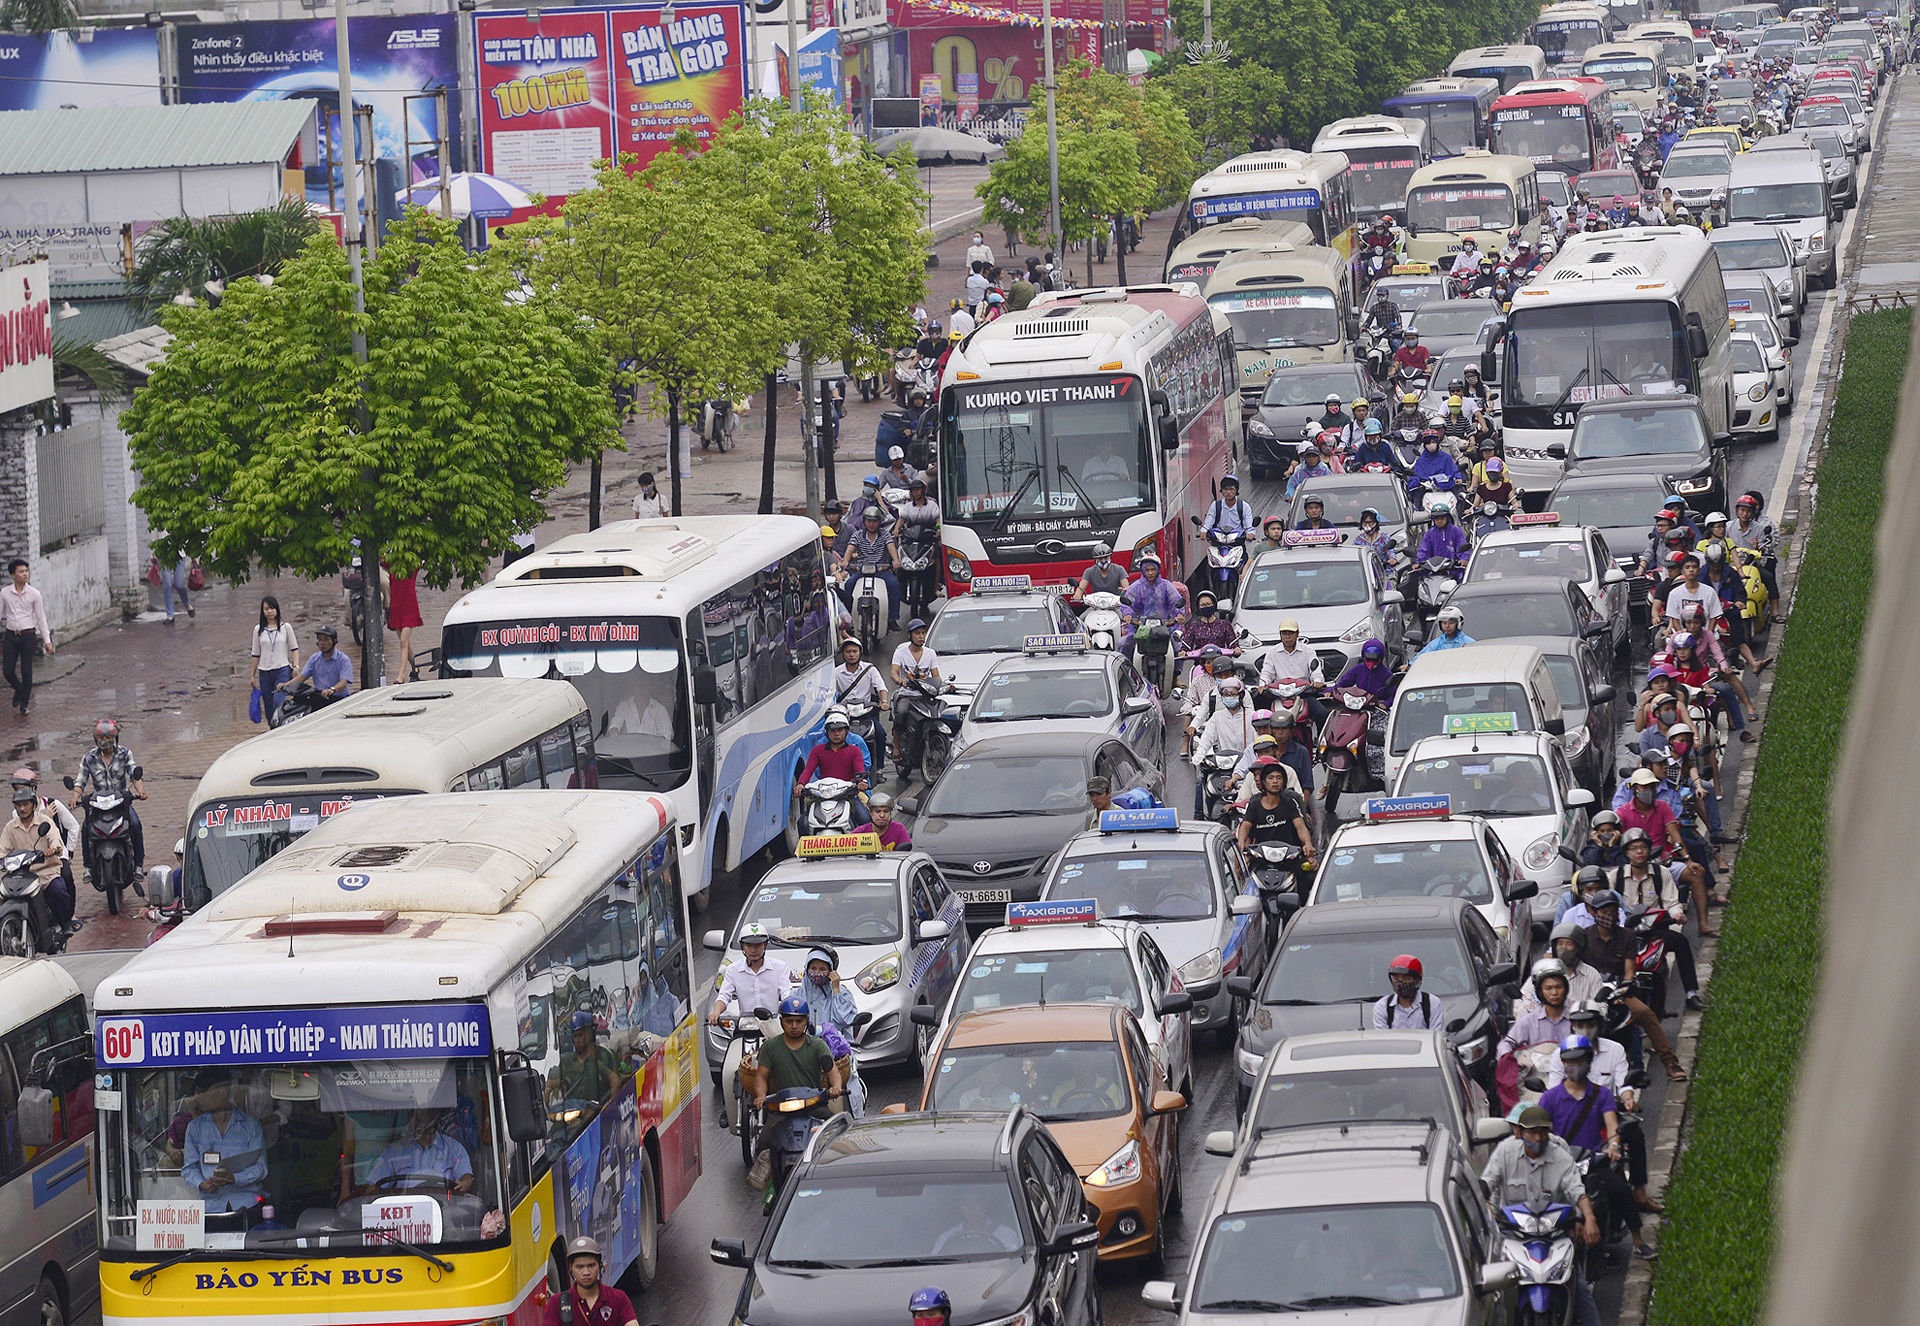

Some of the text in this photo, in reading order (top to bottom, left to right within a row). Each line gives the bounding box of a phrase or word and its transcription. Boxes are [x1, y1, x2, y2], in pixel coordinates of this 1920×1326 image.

[387, 28, 440, 44] ASUS
[622, 14, 724, 54] BÁN HÀNG
[192, 36, 242, 49] Zenfone 2
[522, 33, 598, 64] TẬN NHÀ
[194, 53, 220, 66] Nhìn
[248, 50, 273, 64] điều
[274, 50, 300, 63] khác
[302, 48, 324, 64] biệt
[627, 39, 728, 84] TRẢ GÓP
[492, 77, 590, 117] 100KM
[640, 99, 692, 110] Lãi suất thấp
[640, 114, 710, 126] Thủ tục đơn giản
[641, 131, 655, 140] Xét
[1311, 196, 1315, 206] 2
[16, 226, 40, 238] NHÀ
[72, 226, 112, 237] TRANG
[68, 252, 100, 260] KHU B
[1180, 265, 1203, 276] YÊN
[1246, 298, 1254, 308] XE
[1274, 296, 1286, 306] CAO
[1244, 359, 1268, 378] NAM
[965, 384, 1116, 408] KUMHO VIET THANH
[960, 496, 979, 512] MỸ
[1051, 496, 1076, 507] SDV
[1018, 522, 1032, 533] ĐÌNH
[1046, 519, 1062, 531] CHÁY
[976, 578, 990, 588] SAO
[482, 630, 498, 646] BX
[500, 624, 539, 648] QUỲNH
[540, 622, 560, 642] CÔI
[570, 625, 587, 642] BX
[589, 622, 608, 642] MỸ
[609, 622, 639, 642] ĐÌNH
[1028, 637, 1044, 646] SAO
[1470, 720, 1510, 728] TAXI
[206, 804, 229, 828] LÝ
[234, 800, 292, 824] NHÂN
[1108, 814, 1126, 822] BA
[106, 1024, 142, 1058] 60A
[151, 1031, 180, 1057] KĐT
[184, 1024, 226, 1056] PHÁP
[230, 1024, 261, 1054] VÂN
[266, 1020, 286, 1053] TỨ
[289, 1022, 325, 1057] HIỆP
[340, 1024, 378, 1050] NAM
[381, 1018, 434, 1049] THĂNG
[438, 1021, 479, 1048] LONG
[142, 1204, 200, 1224] BX. NƯỚC NGẦM
[380, 1206, 414, 1220] KĐT
[167, 1230, 185, 1249] ĐÌNH
[403, 1220, 412, 1244] TỨ
[414, 1220, 432, 1244] HIỆP
[195, 1264, 404, 1290] BẢO YẾN BUS
